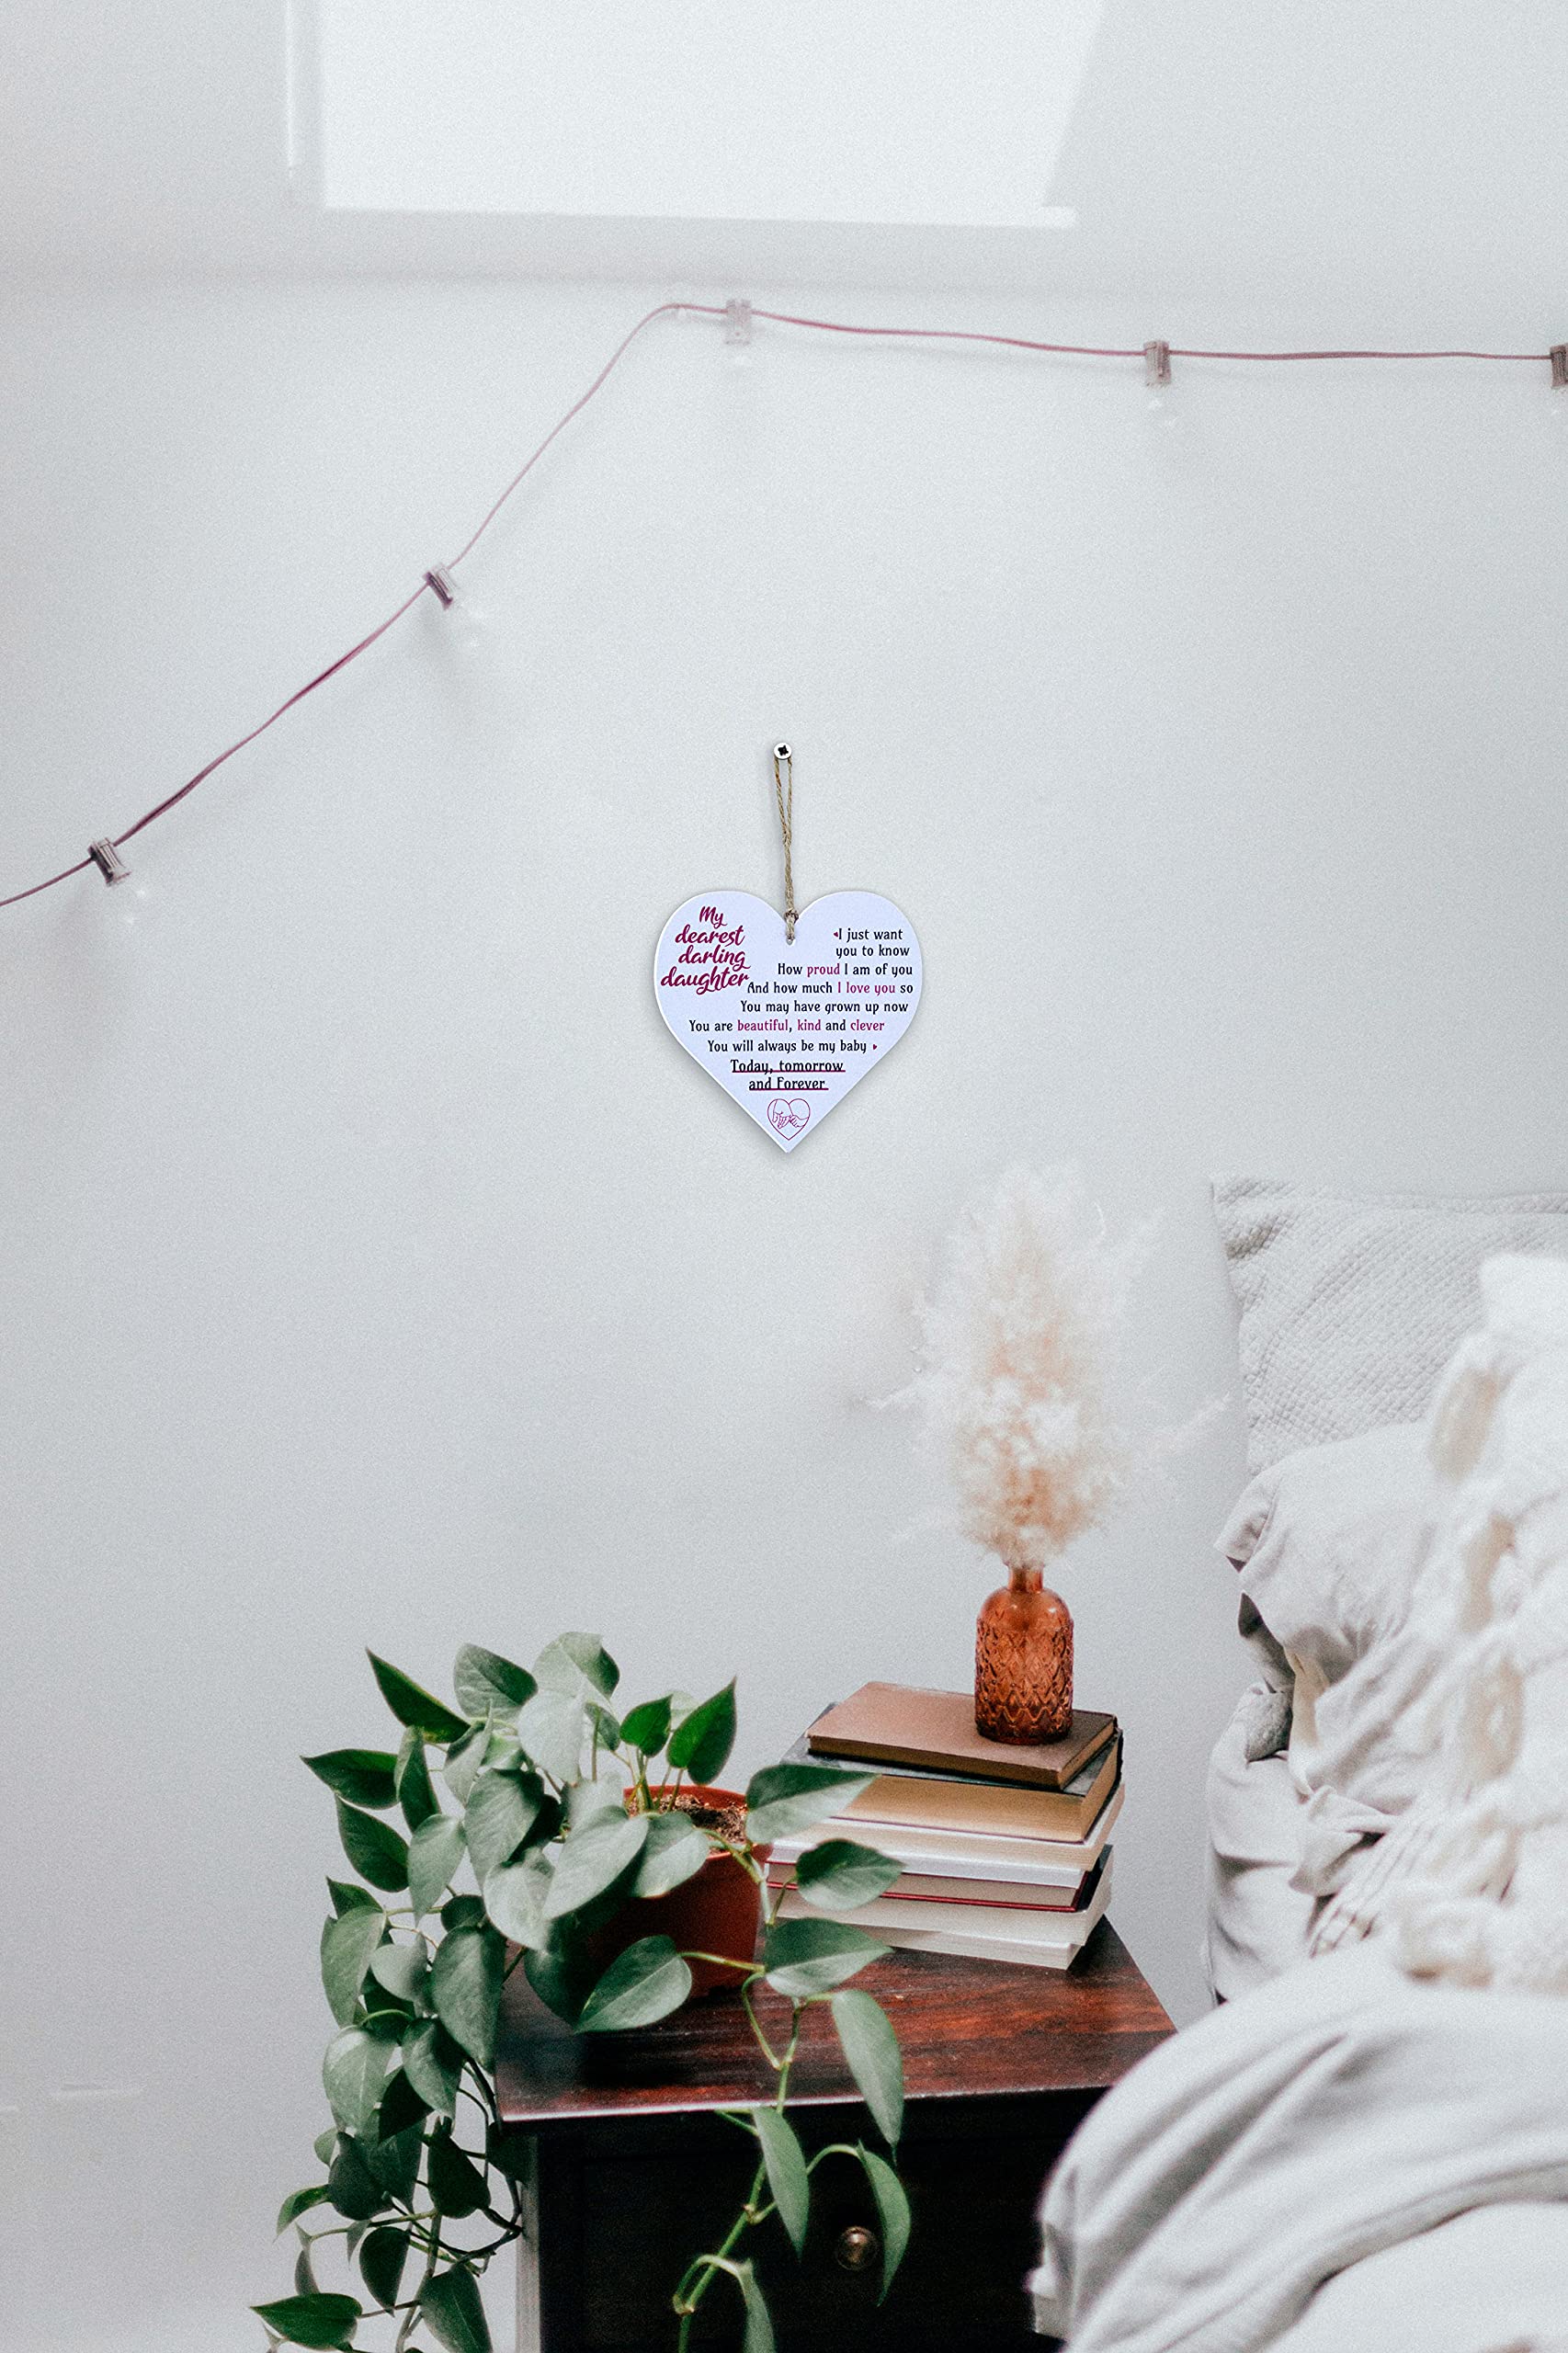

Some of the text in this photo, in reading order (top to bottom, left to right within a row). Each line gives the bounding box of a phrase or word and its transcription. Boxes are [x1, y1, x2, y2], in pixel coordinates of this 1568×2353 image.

[699, 905, 728, 929] My
[675, 925, 745, 947] dearest
[838, 927, 903, 944] I just want
[678, 944, 751, 972] darling
[835, 944, 910, 960] you to know
[778, 962, 913, 979] How proud I am of you
[660, 965, 750, 995] daughter
[746, 981, 914, 996] And how much I love you so
[740, 999, 909, 1016] You may have grown up now
[688, 1018, 885, 1034] You are beautiful, kind and clever
[707, 1039, 867, 1054] You will always be my baby
[730, 1058, 844, 1074] Today, tomorrow
[748, 1076, 826, 1090] and Forever
